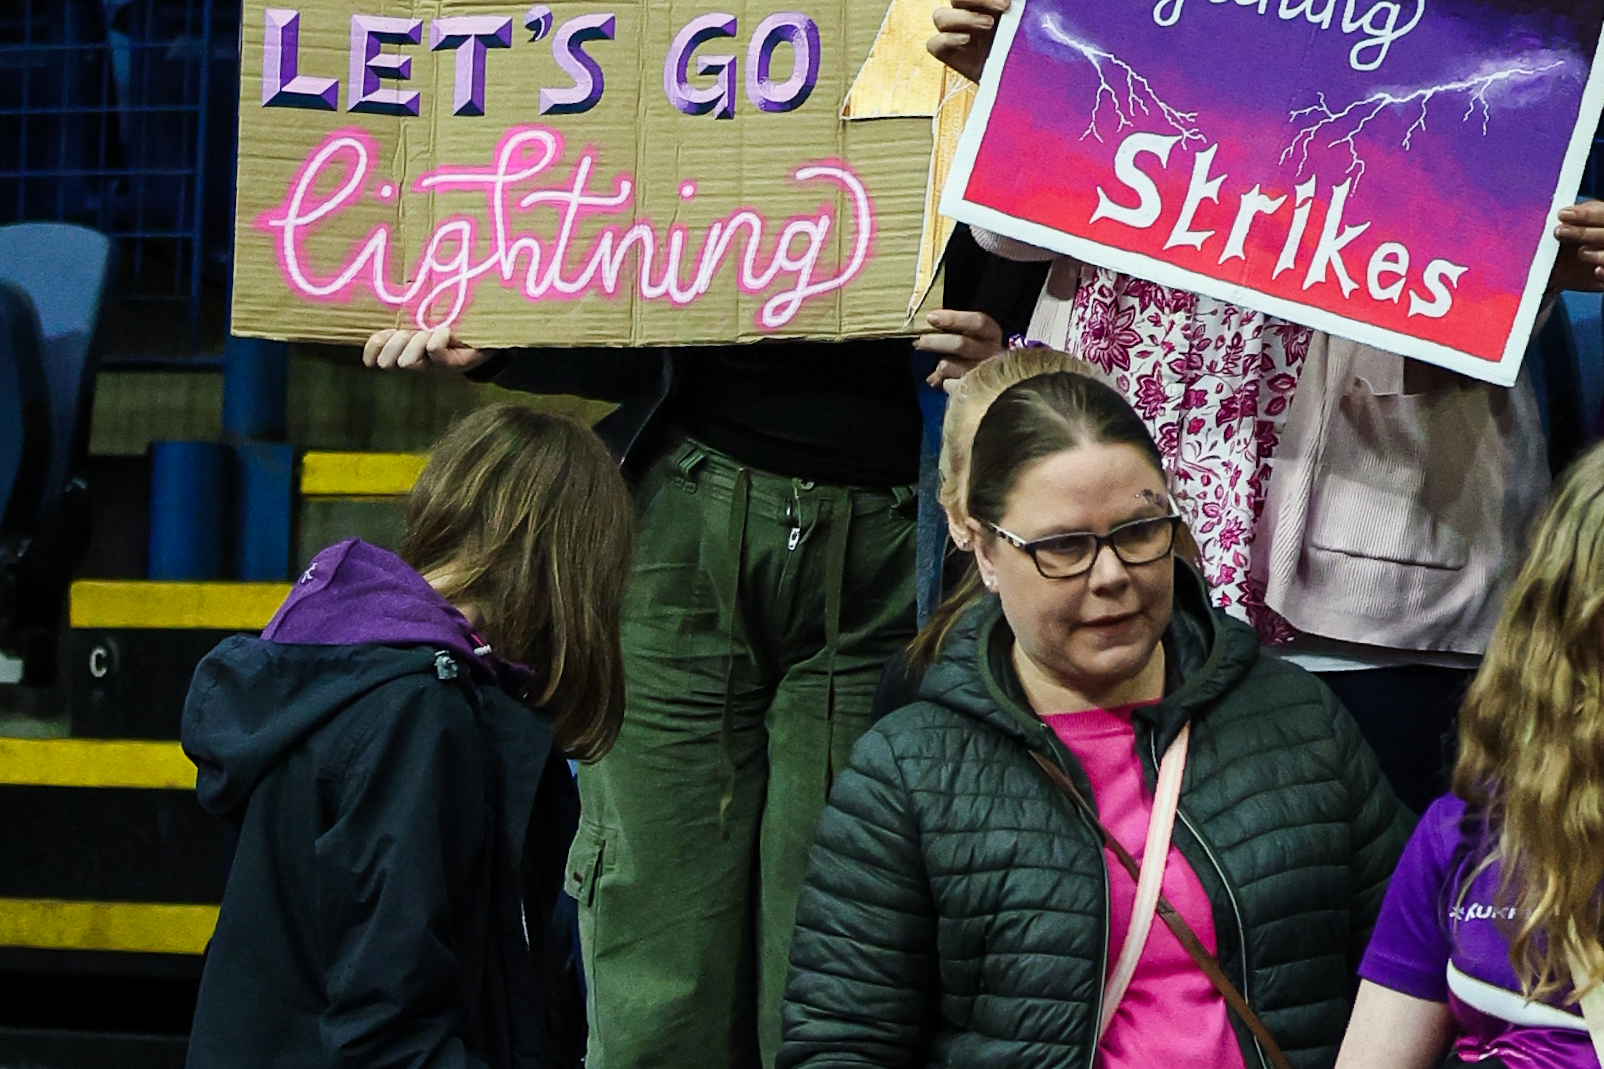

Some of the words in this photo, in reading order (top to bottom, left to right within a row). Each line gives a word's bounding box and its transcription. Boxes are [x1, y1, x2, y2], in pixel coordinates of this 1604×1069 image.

[261, 4, 617, 118] LET'S
[663, 11, 823, 121] GO
[1089, 131, 1468, 318] Strikes
[89, 647, 107, 678] C
